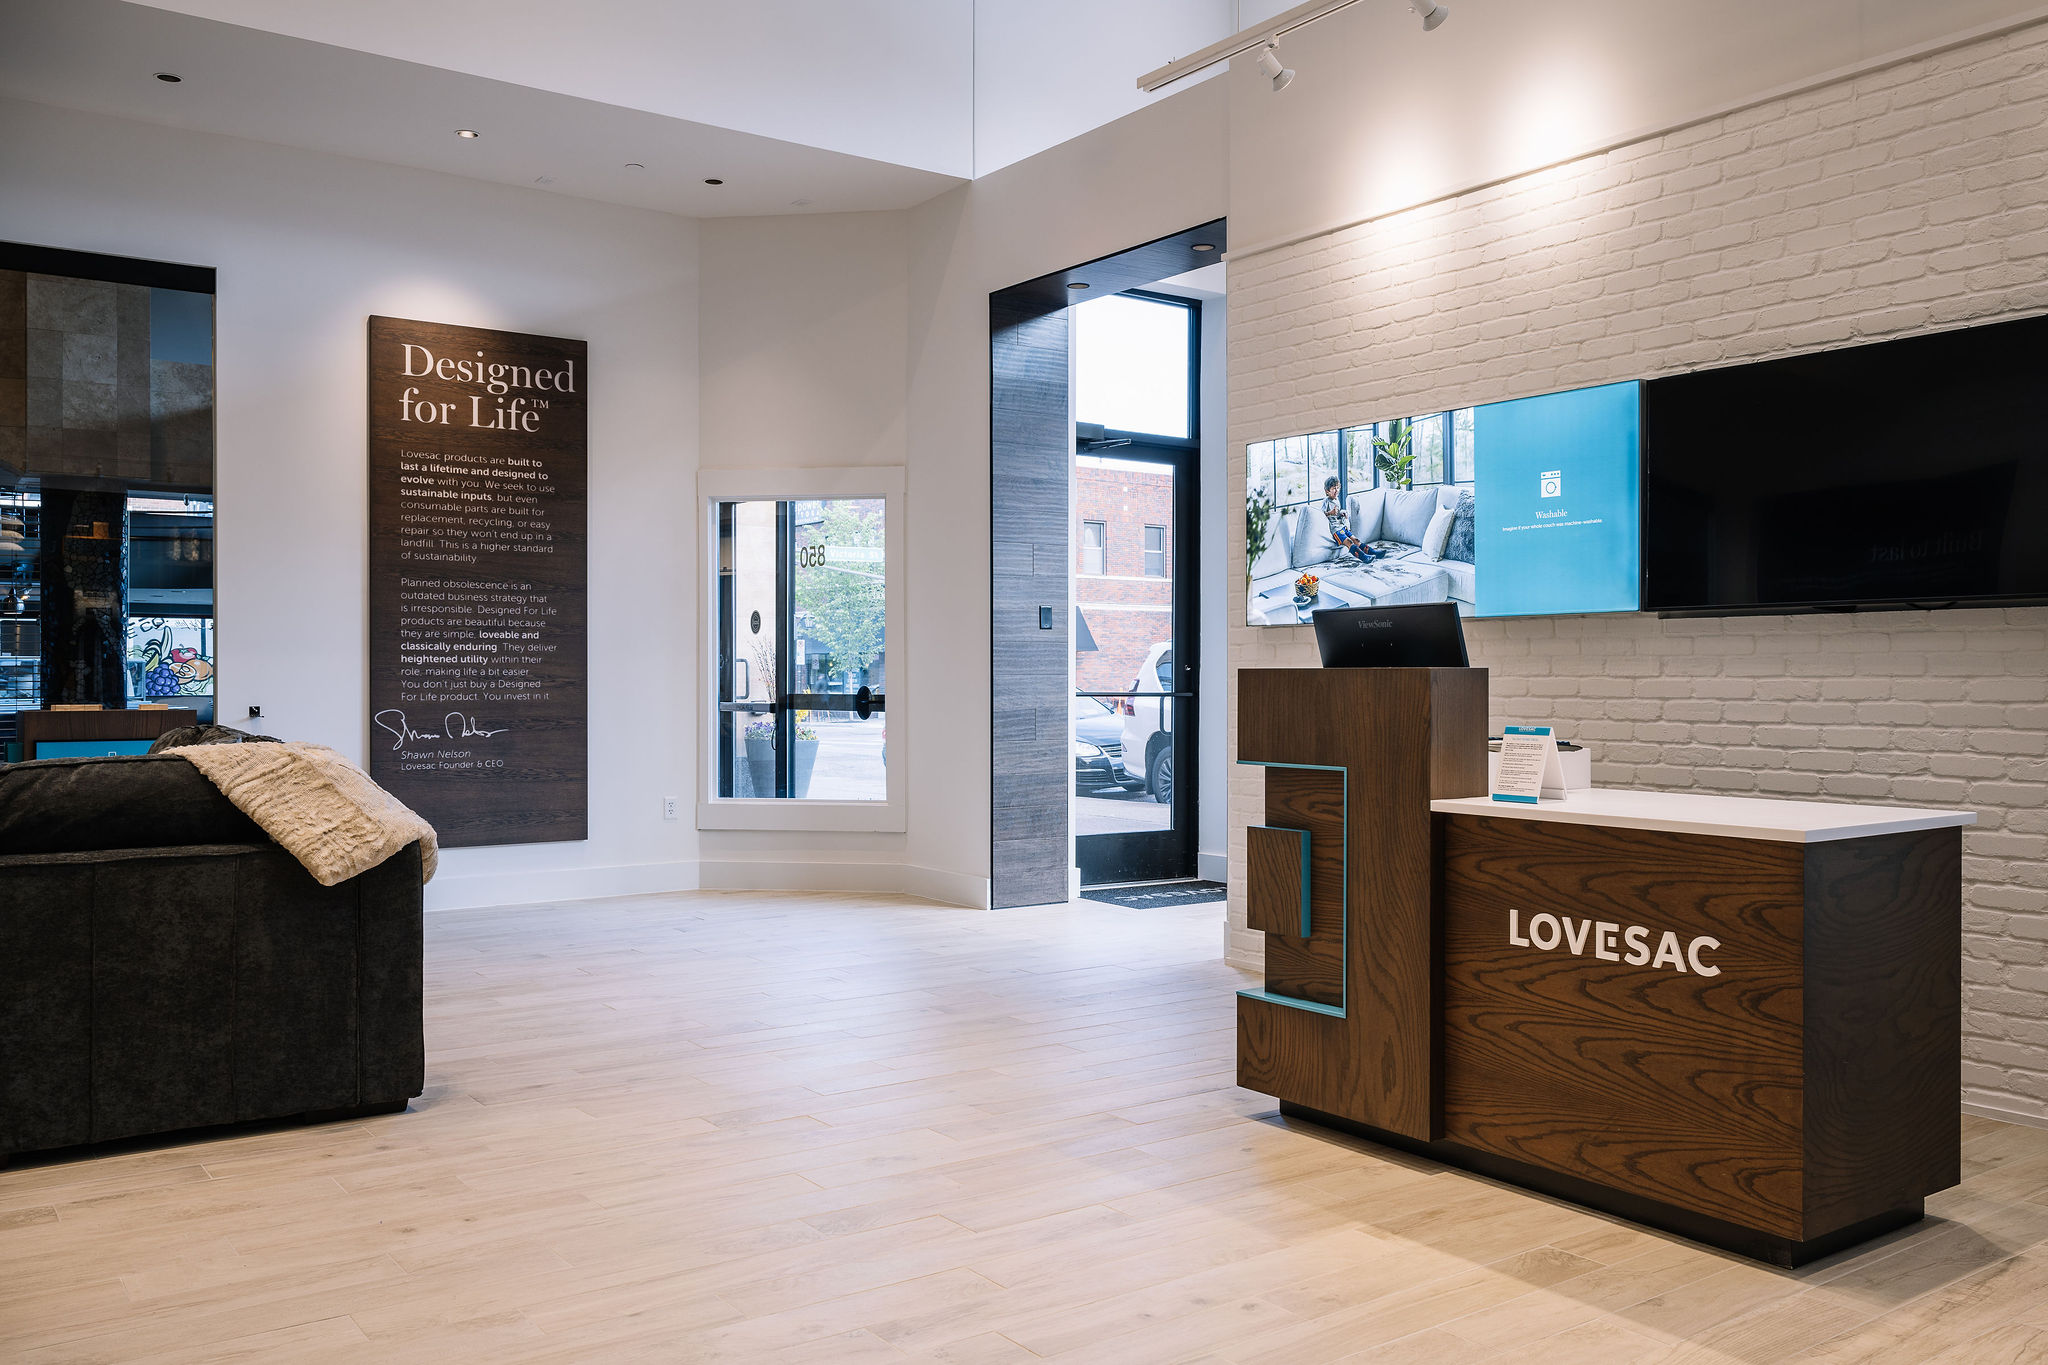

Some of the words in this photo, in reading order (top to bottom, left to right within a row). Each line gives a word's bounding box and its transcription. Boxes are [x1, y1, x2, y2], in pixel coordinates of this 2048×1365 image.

[401, 343, 576, 394] Designed
[399, 387, 456, 424] for
[401, 450, 440, 460] Lovesac
[444, 453, 487, 463] products
[508, 458, 529, 466] built
[532, 459, 542, 467] to
[401, 462, 419, 470] last
[430, 464, 469, 474] lifetime
[471, 468, 489, 476] and
[492, 469, 536, 480] designed
[538, 472, 549, 480] to
[401, 475, 434, 484] evolve
[437, 478, 458, 486] with
[485, 481, 500, 489] We
[503, 481, 524, 490] seek
[401, 488, 458, 499] sustainable
[497, 494, 512, 502] but
[401, 501, 462, 511] consumable
[465, 504, 488, 513] parts
[532, 508, 545, 516] for
[1535, 508, 1568, 519] Washable
[530, 522, 550, 530] easy
[401, 526, 429, 536] repair
[447, 529, 468, 538] they
[500, 531, 518, 539] end
[521, 533, 533, 541] up
[440, 540, 459, 548] This
[480, 543, 510, 552] higher
[513, 545, 553, 553] standard
[401, 551, 411, 559] of
[401, 578, 440, 587] Planned
[443, 581, 508, 590] obsolescence
[401, 592, 445, 600] outdated
[448, 593, 488, 601] business
[491, 595, 527, 604] strategy
[530, 595, 547, 603] that
[478, 605, 520, 616] Designed
[524, 607, 538, 615] For
[541, 607, 557, 615] Life
[401, 617, 444, 627] products
[465, 618, 505, 627] beautiful
[508, 619, 546, 627] because
[1358, 619, 1393, 629] ViewSonic
[401, 630, 421, 639] they
[479, 631, 519, 639] loveable
[522, 631, 539, 639] and
[401, 642, 451, 652] classically
[502, 643, 525, 653] They
[528, 644, 557, 652] deliver
[401, 655, 458, 664] heightened
[461, 655, 488, 665] utility
[491, 656, 519, 664] within
[425, 668, 461, 677] making
[464, 668, 477, 676] life
[488, 668, 500, 676] bit
[401, 680, 420, 688] You
[450, 680, 467, 690] just
[470, 680, 487, 690] buy
[498, 680, 541, 690] Designed
[401, 693, 417, 701] For
[420, 693, 437, 701] Life
[483, 692, 501, 701] You
[401, 750, 434, 760] Shawn
[438, 749, 471, 758] Nelson
[401, 762, 435, 770] Lovesac
[439, 761, 473, 769] Founder
[485, 760, 504, 768] CEO
[1509, 908, 1722, 977] LOVESAC
